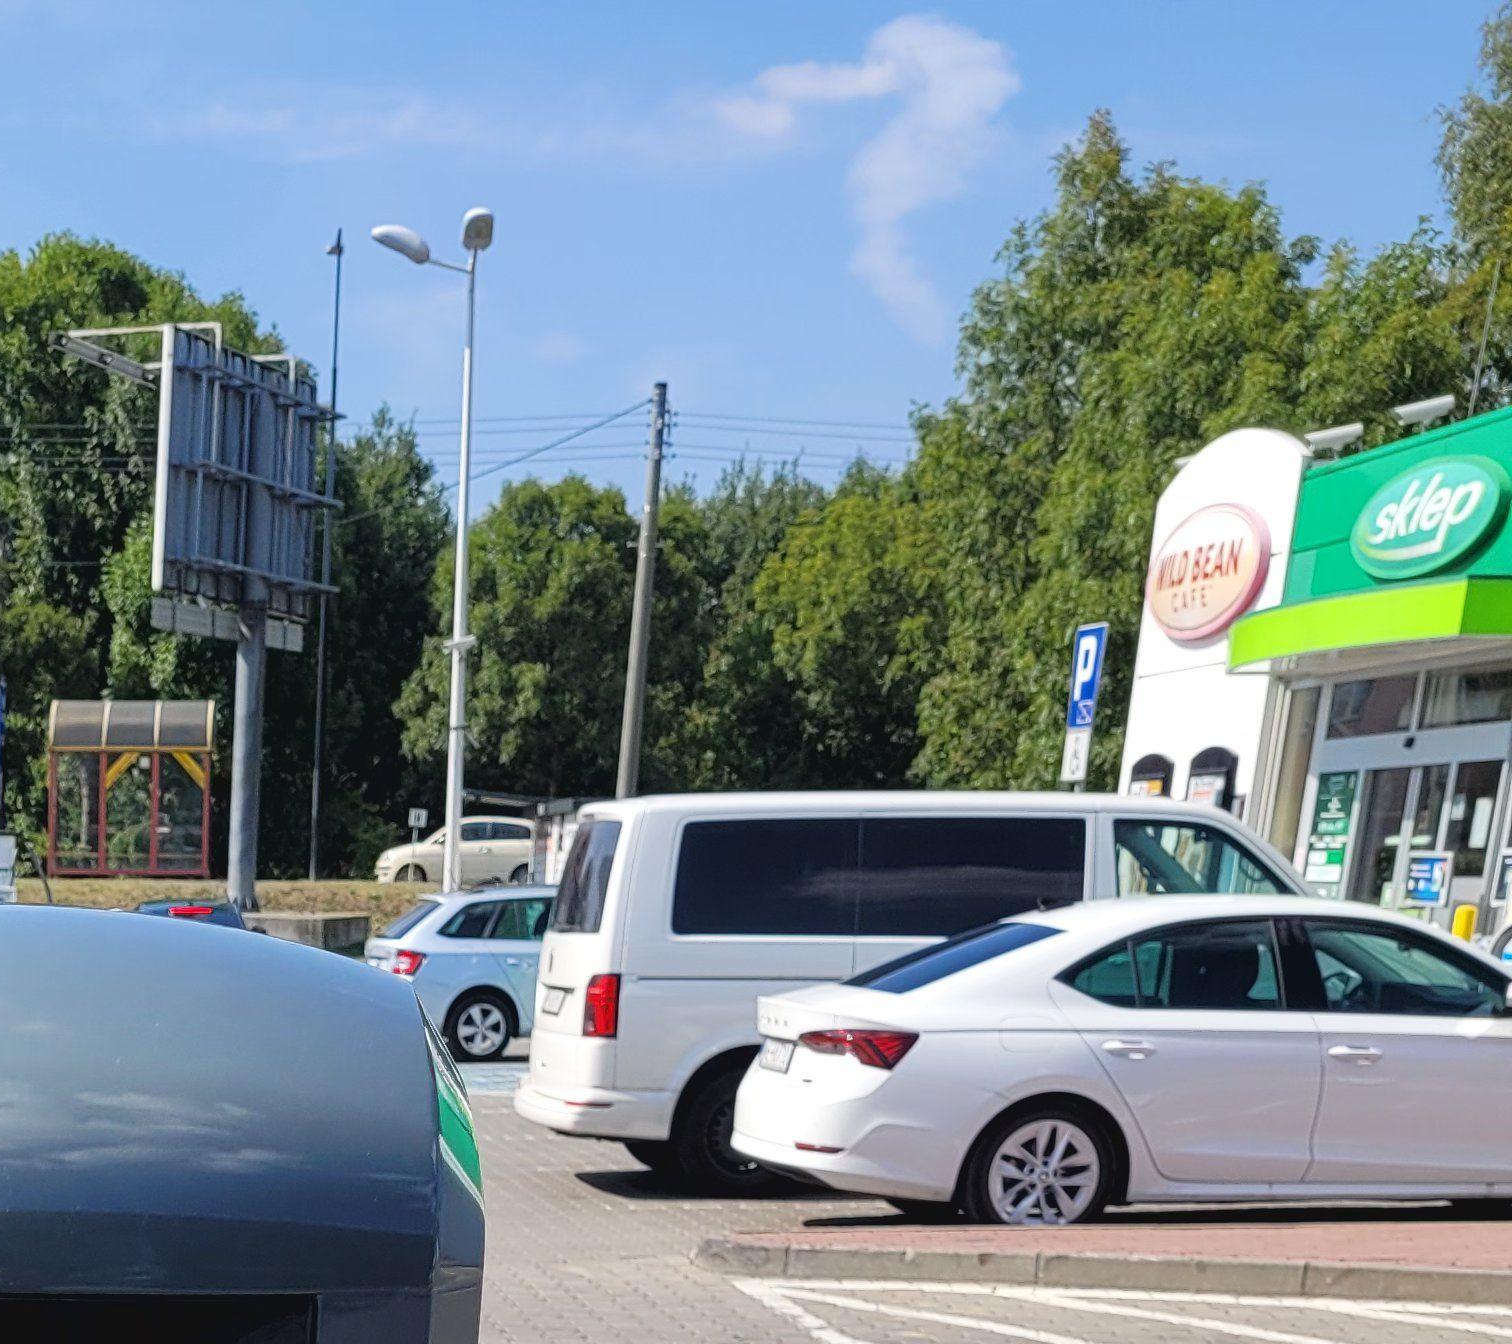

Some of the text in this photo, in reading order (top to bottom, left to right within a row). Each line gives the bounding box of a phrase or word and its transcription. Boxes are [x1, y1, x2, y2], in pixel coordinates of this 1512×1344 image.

[1368, 473, 1486, 552] sklep
[1157, 537, 1243, 591] WILD BEAN
[1074, 635, 1098, 701] P
